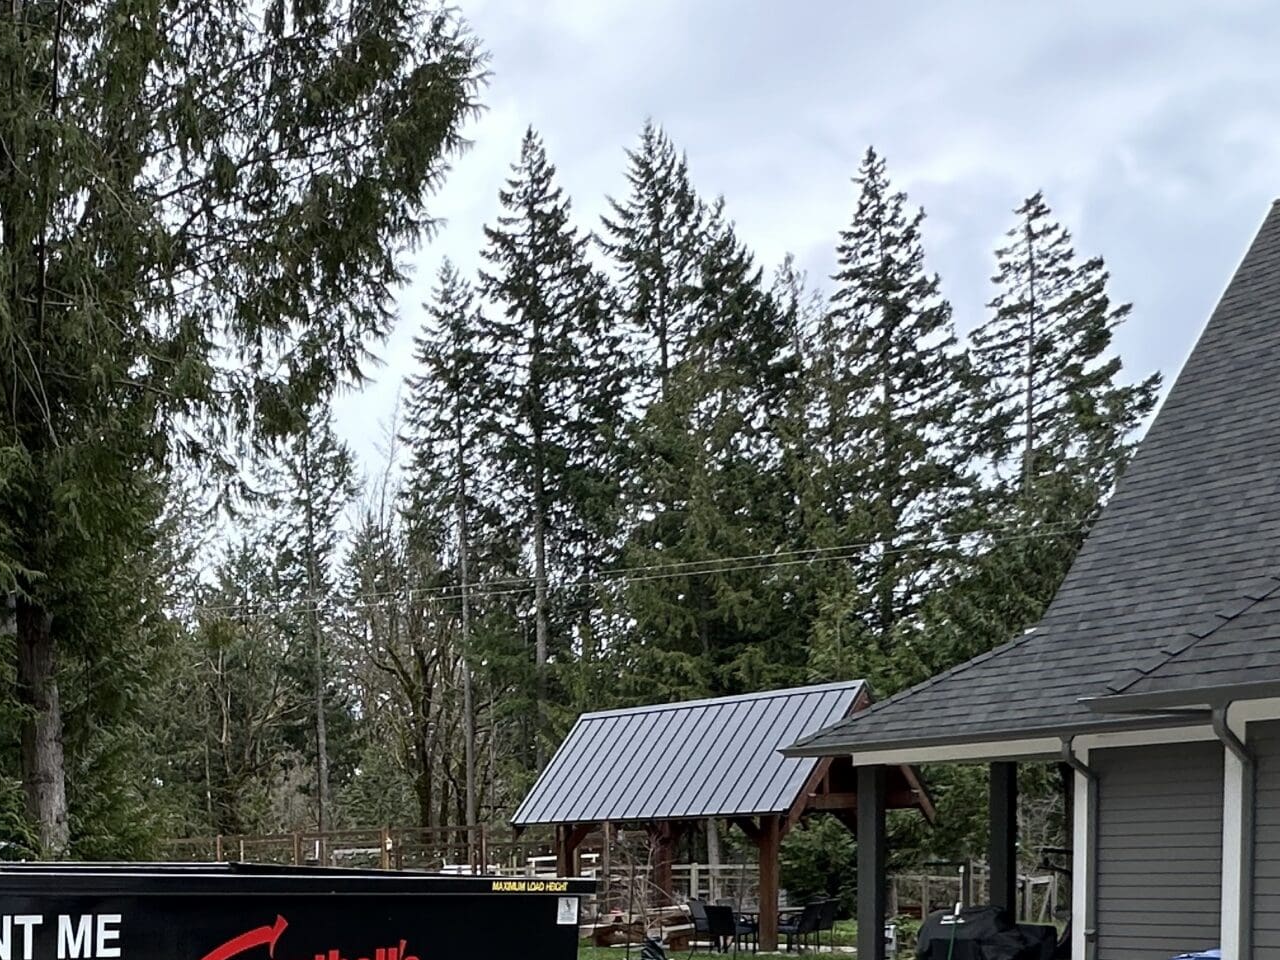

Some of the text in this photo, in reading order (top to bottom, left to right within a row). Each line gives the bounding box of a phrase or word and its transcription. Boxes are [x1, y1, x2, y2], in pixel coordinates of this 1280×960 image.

[492, 881, 568, 892] MAXIMUM LOAD HEIGHT
[57, 914, 122, 960] ME
